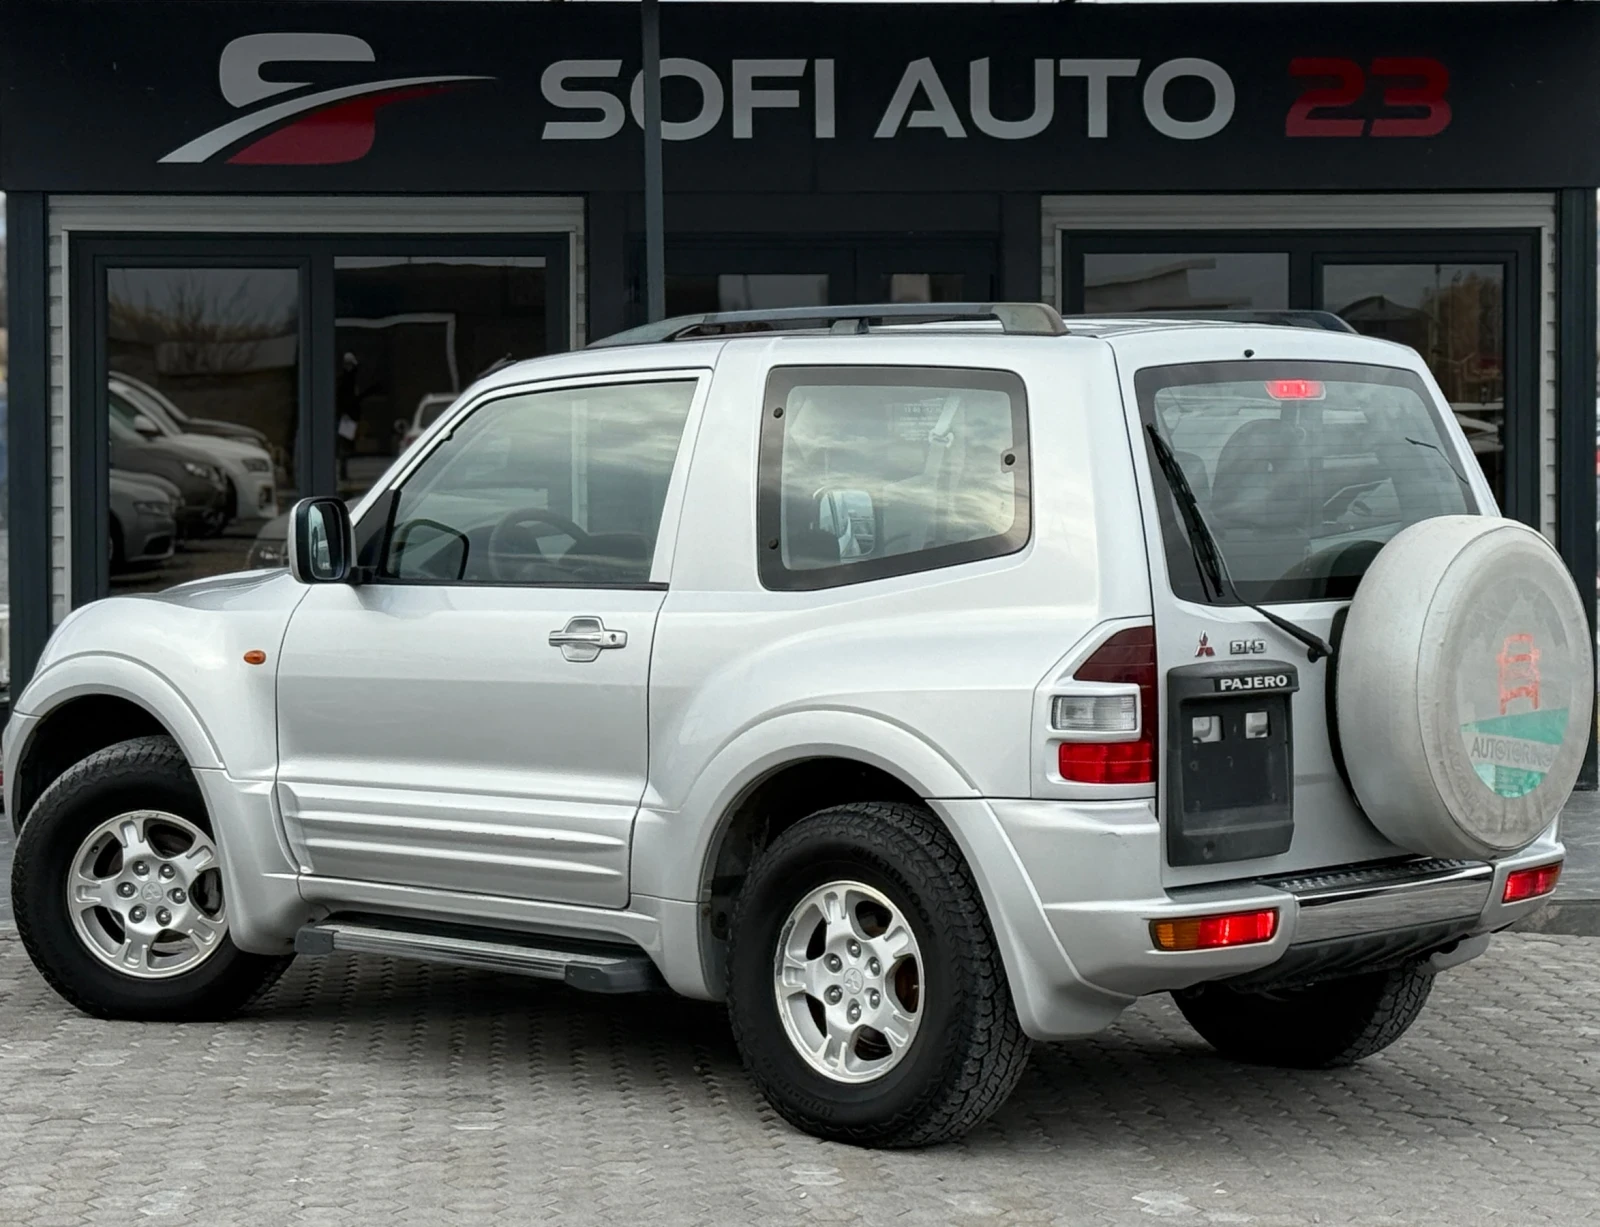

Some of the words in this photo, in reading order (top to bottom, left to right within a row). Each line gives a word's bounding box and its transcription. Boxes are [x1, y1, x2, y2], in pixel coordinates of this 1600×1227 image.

[541, 58, 835, 140] SOFI
[875, 57, 1236, 140] AUTO
[1284, 56, 1453, 138] 23
[1220, 674, 1288, 691] PAJERO
